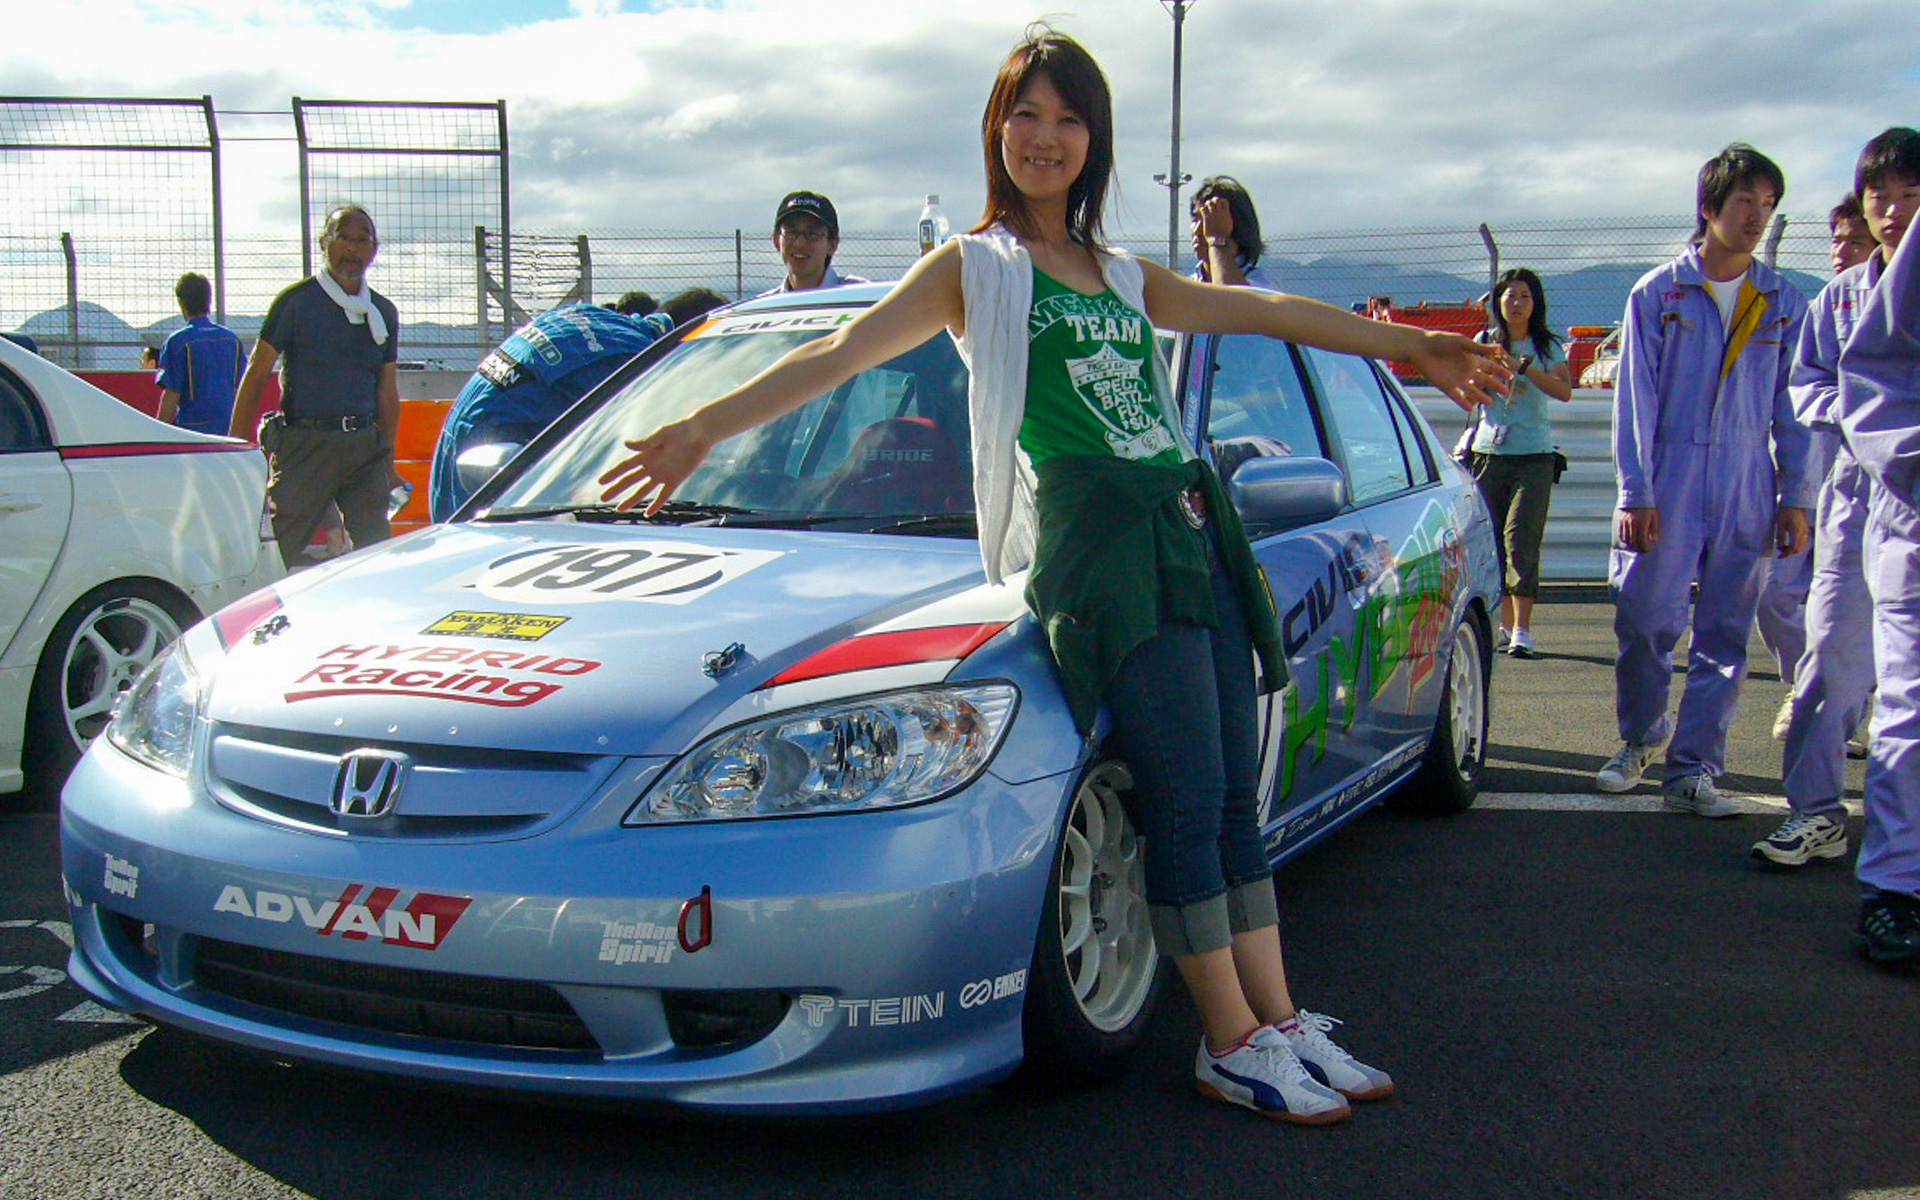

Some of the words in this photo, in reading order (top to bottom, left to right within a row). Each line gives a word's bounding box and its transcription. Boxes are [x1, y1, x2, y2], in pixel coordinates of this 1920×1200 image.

[721, 317, 829, 333] CIVIC
[1065, 315, 1142, 345] TEAM
[493, 548, 722, 593] 197
[317, 643, 602, 677] HYBRID
[295, 663, 564, 704] Racing
[213, 885, 437, 945] ADVAN
[599, 938, 677, 965] Spirit
[839, 991, 944, 1027] TEIN
